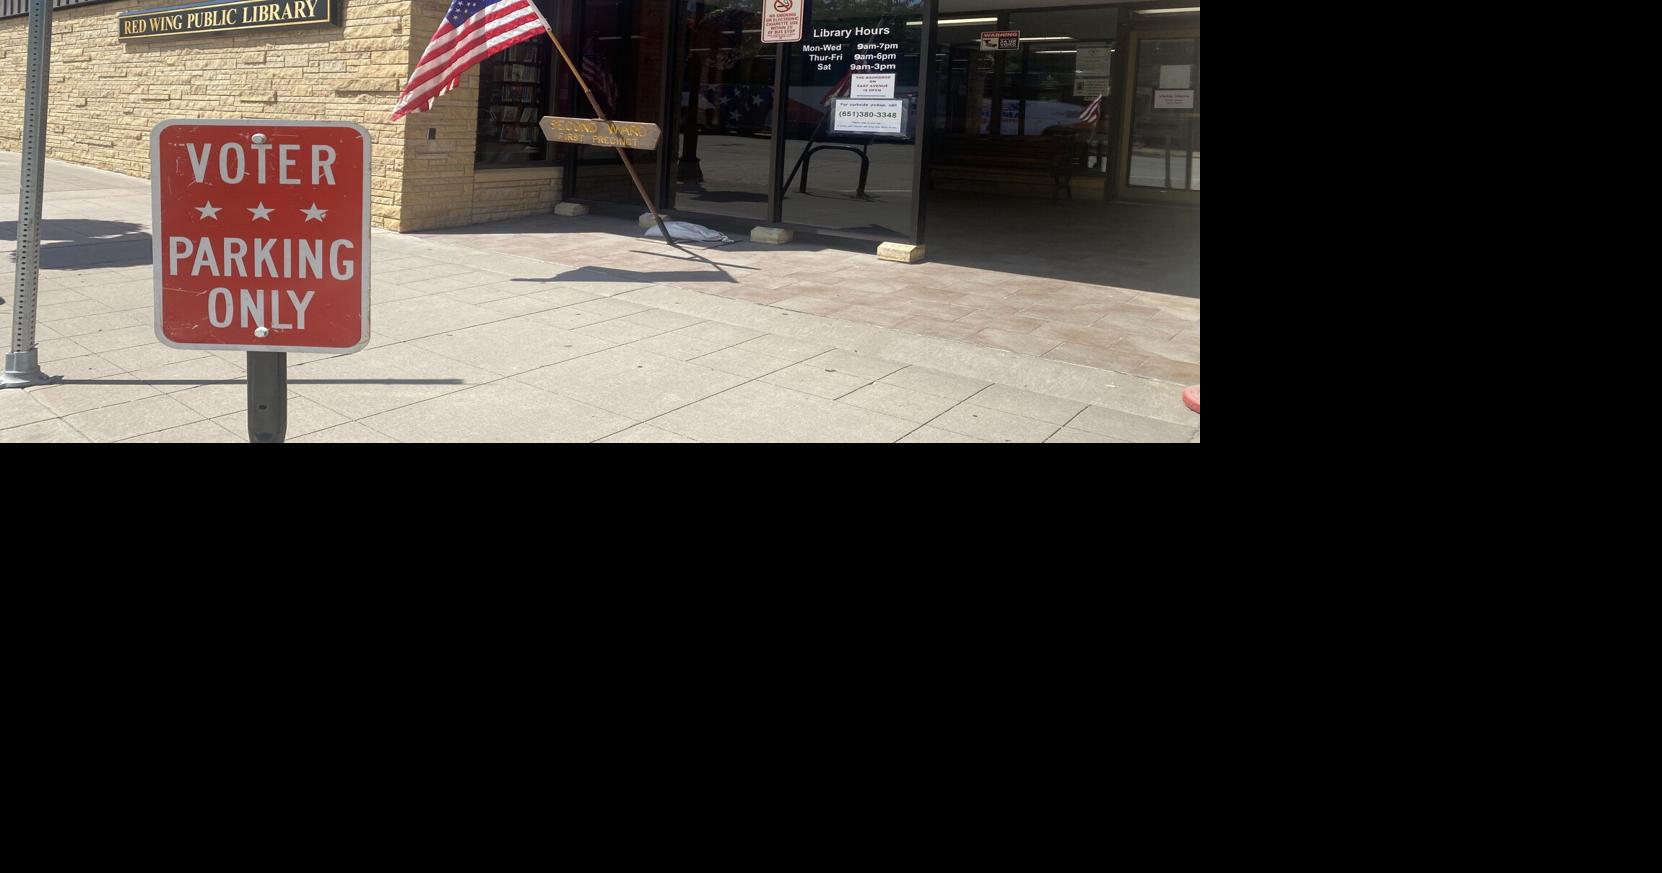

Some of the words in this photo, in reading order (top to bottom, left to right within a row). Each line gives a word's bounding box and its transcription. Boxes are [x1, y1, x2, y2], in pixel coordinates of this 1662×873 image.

[124, 19, 146, 35] RED
[150, 15, 182, 32] WING
[187, 8, 237, 29] PUBLIC
[242, 0, 319, 23] LIBRARY
[813, 28, 852, 38] Library
[855, 26, 890, 36] Hours
[803, 44, 842, 52] Mon-Wed
[857, 43, 898, 51] 9am-7pm
[854, 53, 896, 61] 9am-6pm
[850, 63, 896, 71] 9am-3pm
[838, 110, 897, 118] (651)380-3348
[550, 119, 598, 133] SECOND
[607, 122, 648, 137] WARD
[558, 133, 584, 144] FIRST
[592, 135, 640, 147] PRECINCT
[186, 142, 337, 186] VOTER
[169, 236, 354, 281] PARKING
[207, 287, 315, 330] ONLY
